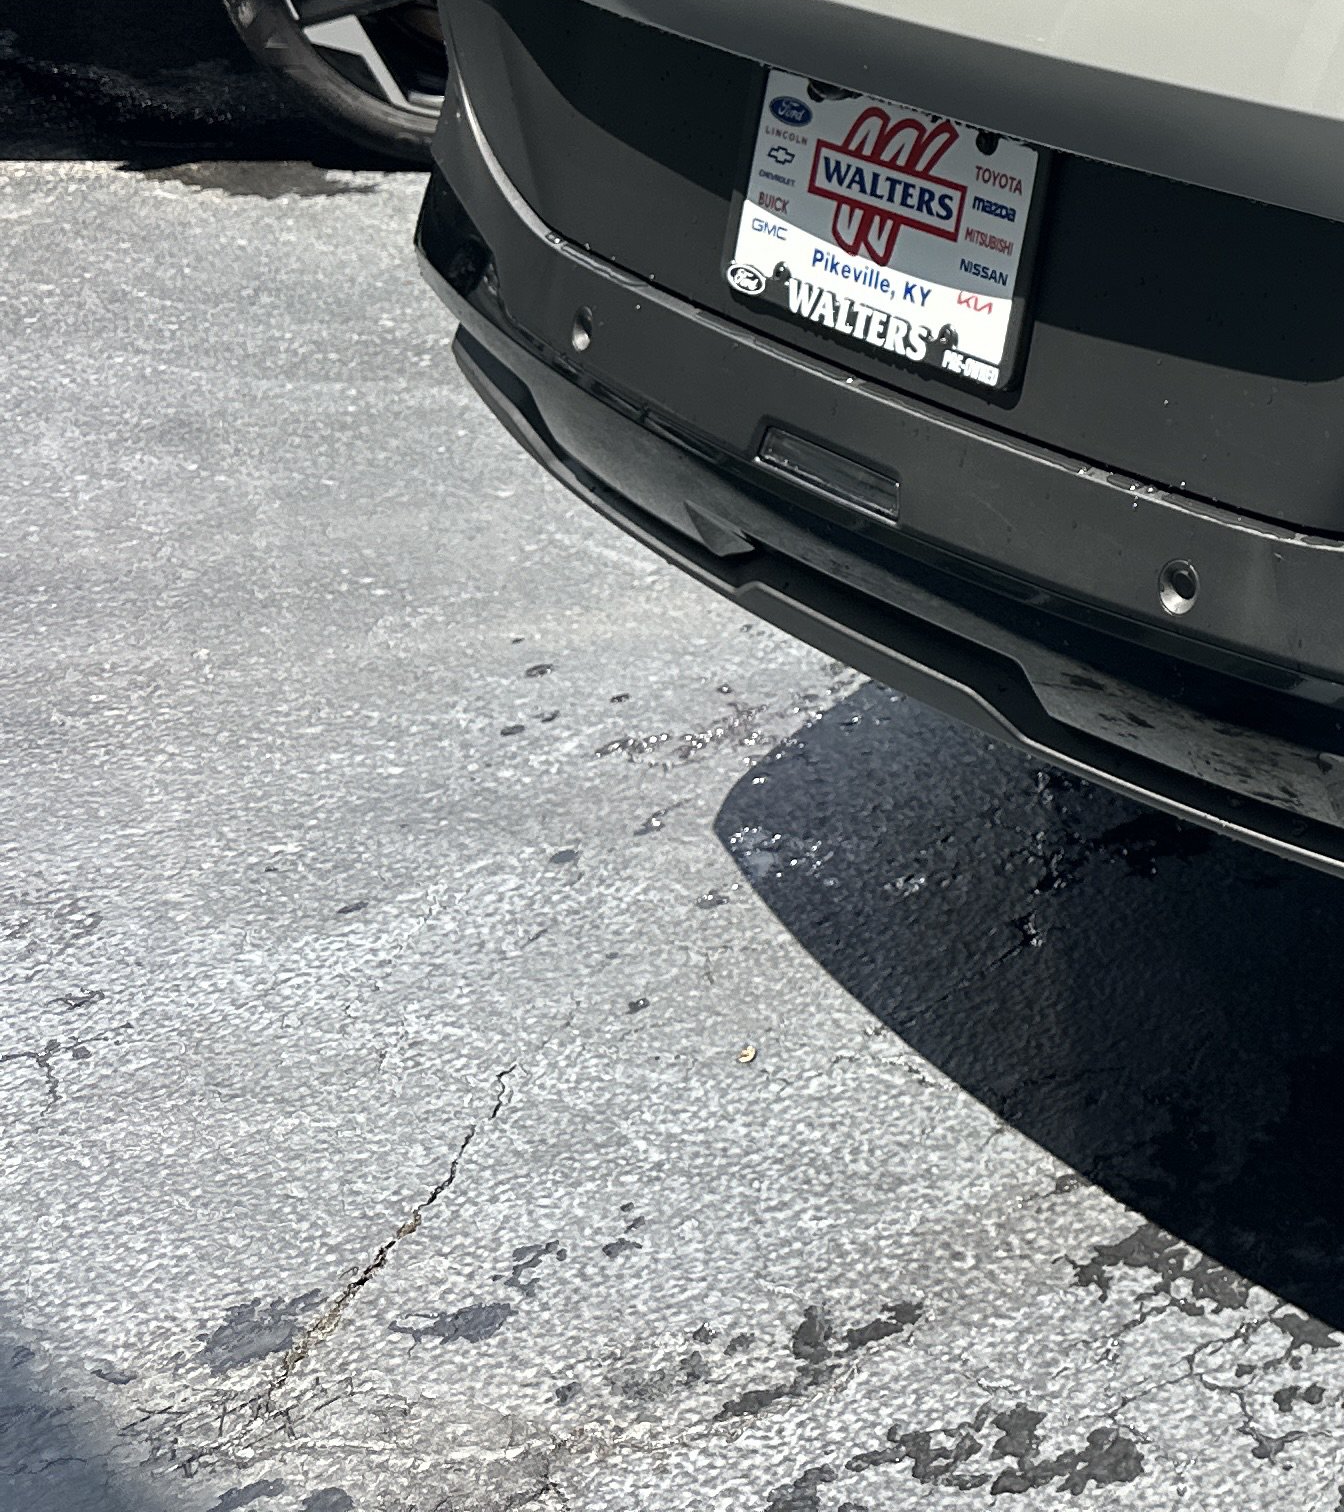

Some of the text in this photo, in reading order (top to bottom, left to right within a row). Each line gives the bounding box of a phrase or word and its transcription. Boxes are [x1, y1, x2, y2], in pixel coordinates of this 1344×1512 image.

[765, 125, 808, 146] LINCOLN
[758, 169, 796, 187] CHEVROLET
[823, 155, 954, 221] WALTERS
[975, 165, 1023, 196] TOYOTA
[757, 191, 790, 215] BUICK
[751, 217, 788, 241] GMC
[964, 226, 1014, 257] MITSUBISHI
[811, 248, 932, 307] Pikeville, KY
[959, 258, 1009, 287] NISSAN
[785, 276, 928, 362] WALTERS
